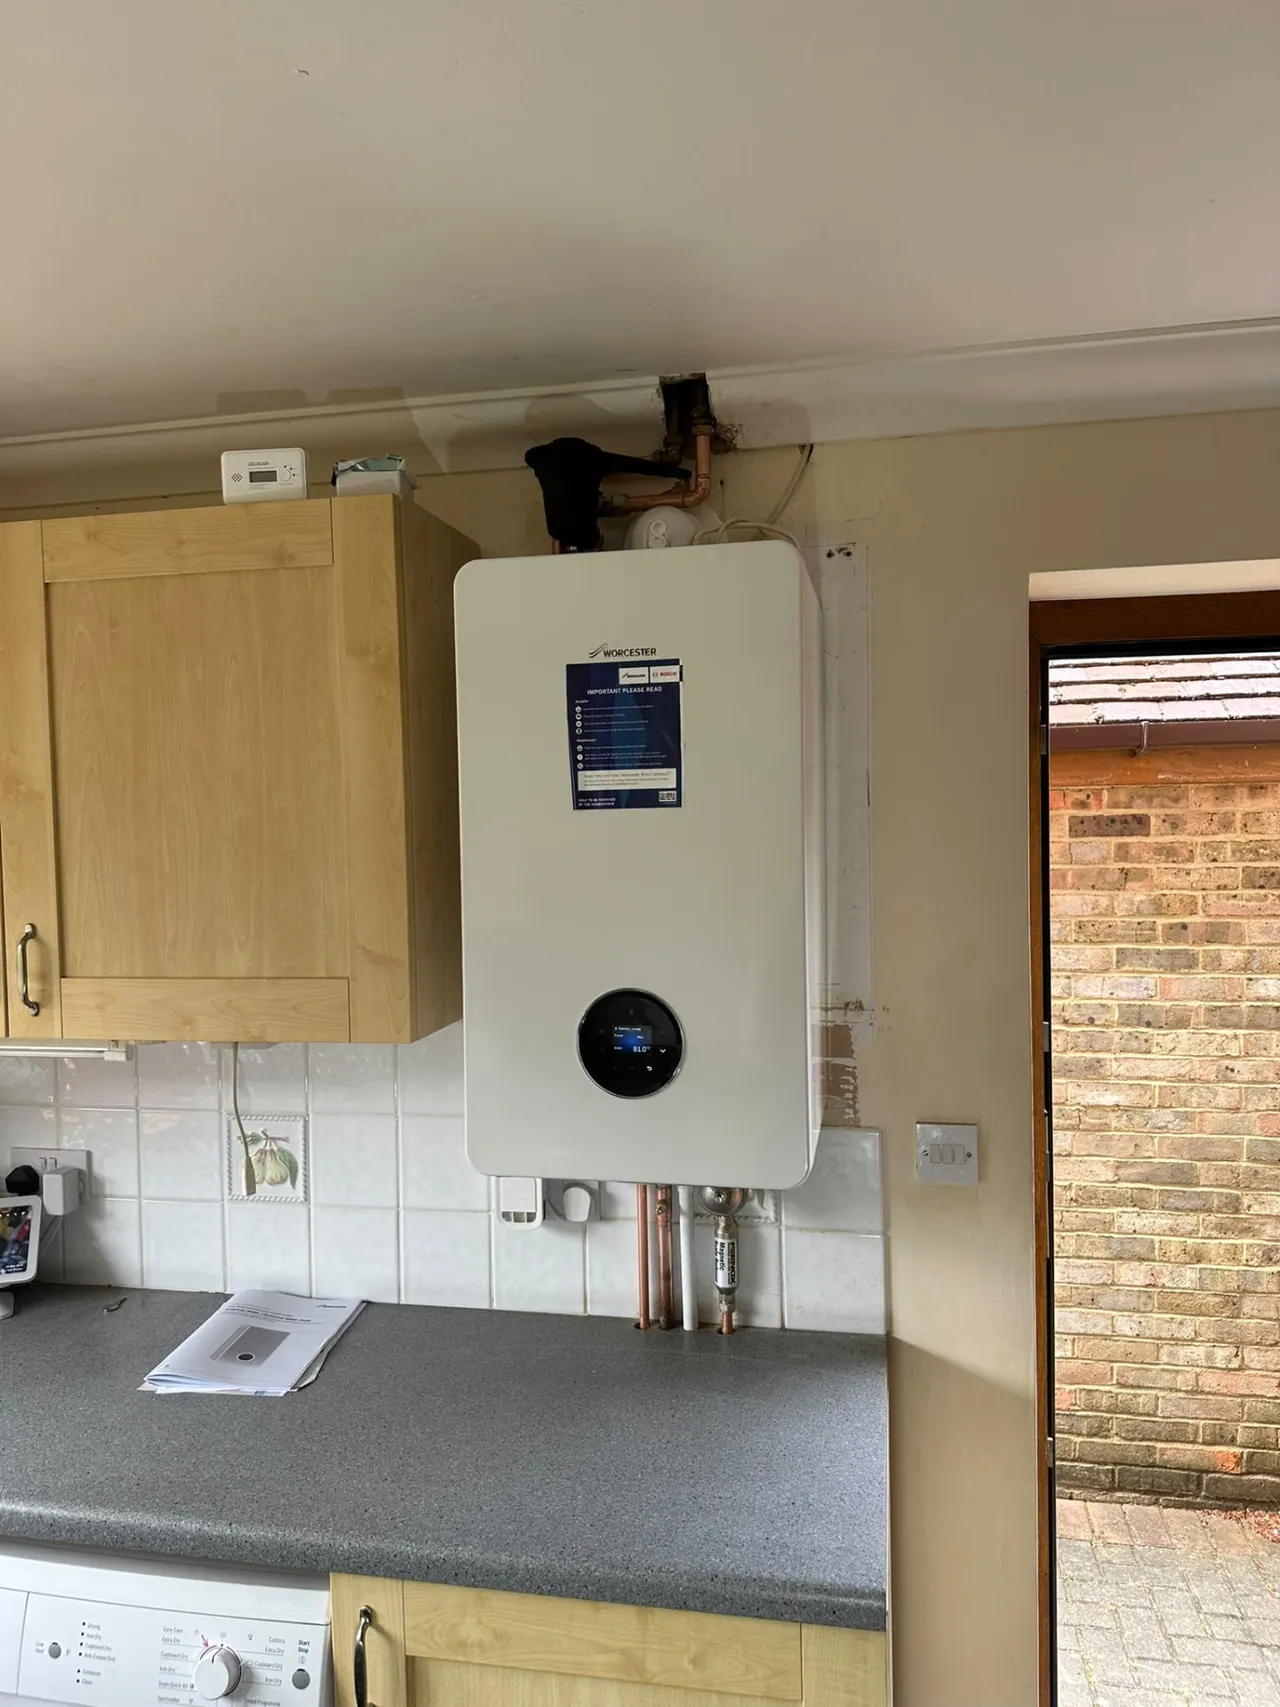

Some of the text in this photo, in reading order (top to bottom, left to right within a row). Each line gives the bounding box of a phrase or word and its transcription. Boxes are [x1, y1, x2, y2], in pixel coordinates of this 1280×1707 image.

[603, 648, 657, 658] WORCESTER
[87, 1622, 101, 1631] Drying
[254, 1660, 275, 1668] Cupboard
